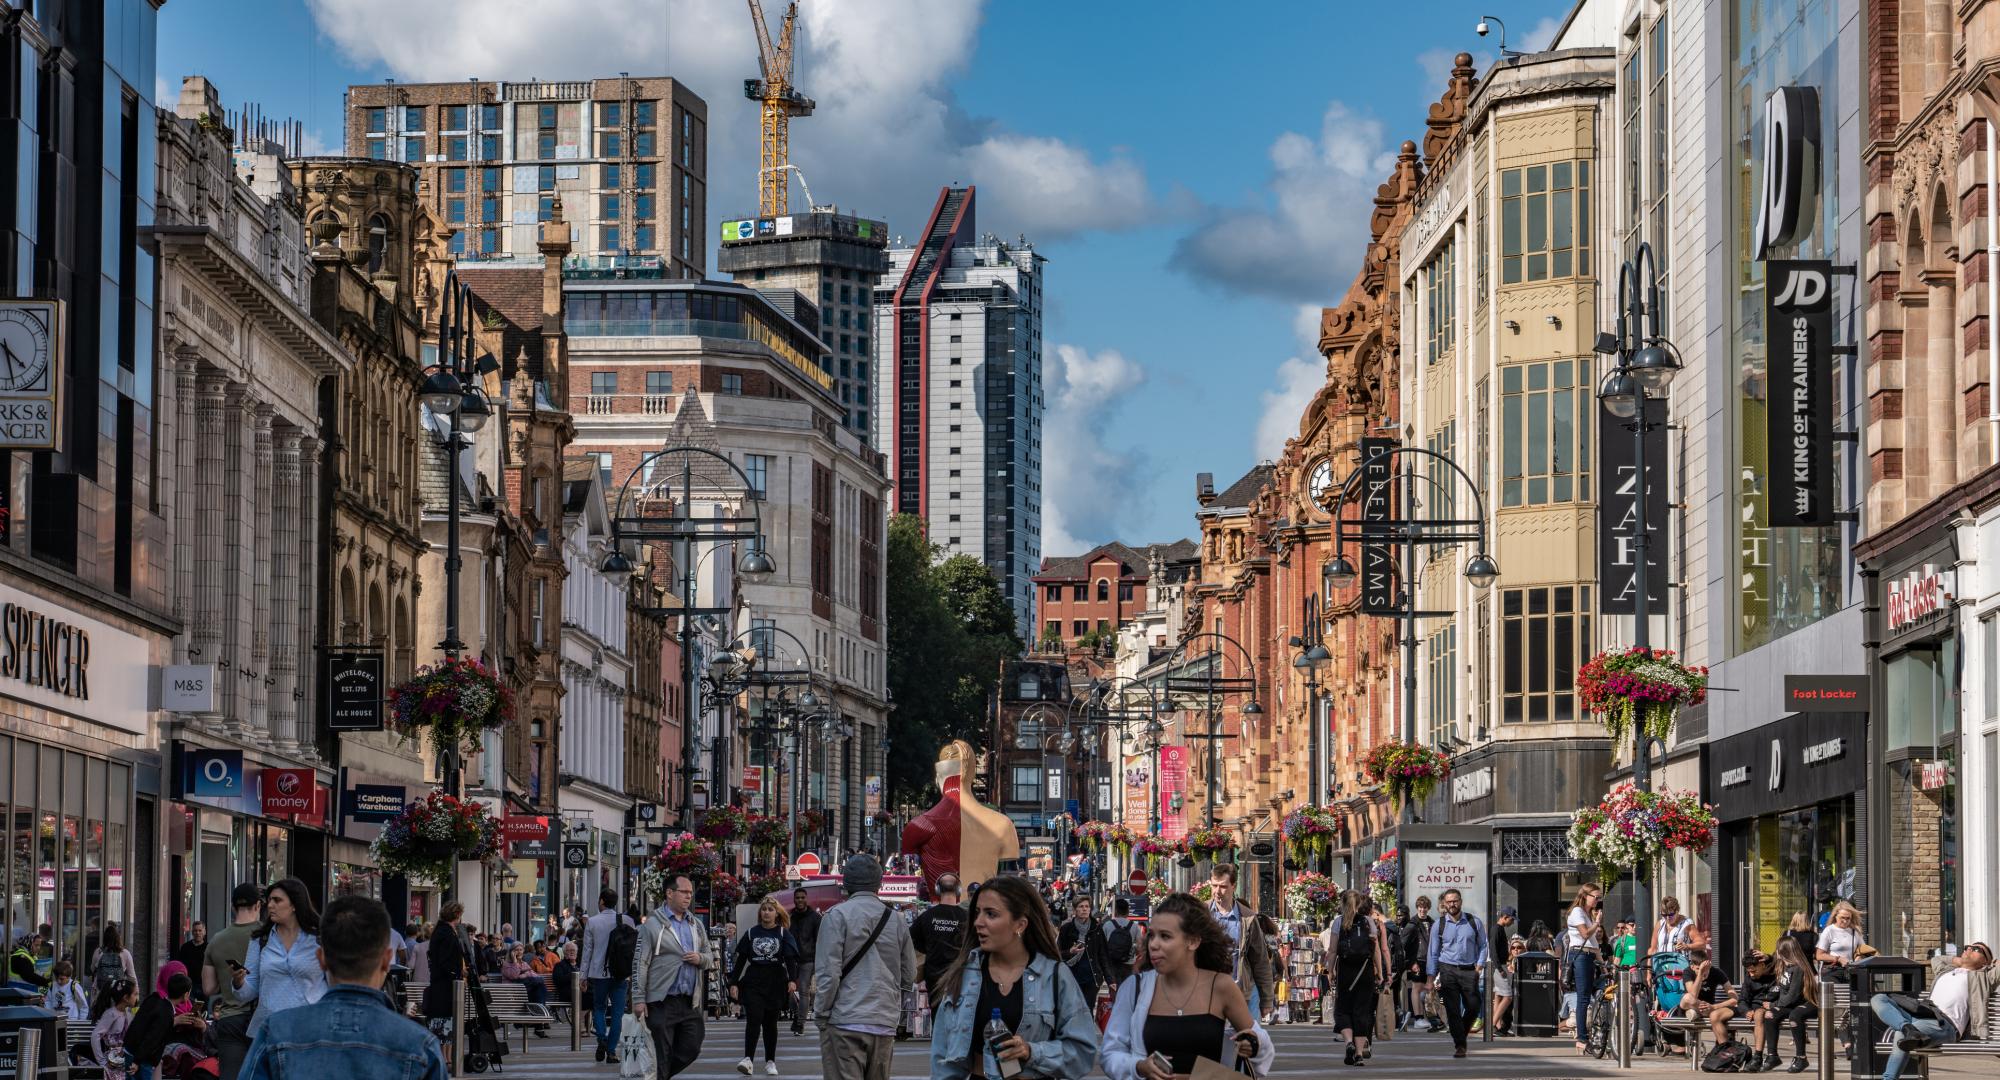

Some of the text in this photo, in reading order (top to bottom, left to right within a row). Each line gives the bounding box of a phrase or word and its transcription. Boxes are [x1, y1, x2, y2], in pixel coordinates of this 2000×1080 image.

[1774, 270, 1827, 306] JD
[1793, 316, 1809, 482] KING OF TRAINERS
[2, 602, 90, 700] SPENCER
[334, 669, 375, 682] WHITELOCKS
[175, 679, 203, 691] M&S
[1794, 688, 1857, 698] Foot Locker
[268, 797, 309, 808] money
[362, 795, 402, 804] Carphone
[1128, 800, 1146, 808] Well
[358, 803, 402, 811] Warehouse
[1417, 875, 1475, 883] CAN DO IT
[932, 917, 960, 926] Personal
[934, 924, 955, 932] Trainer
